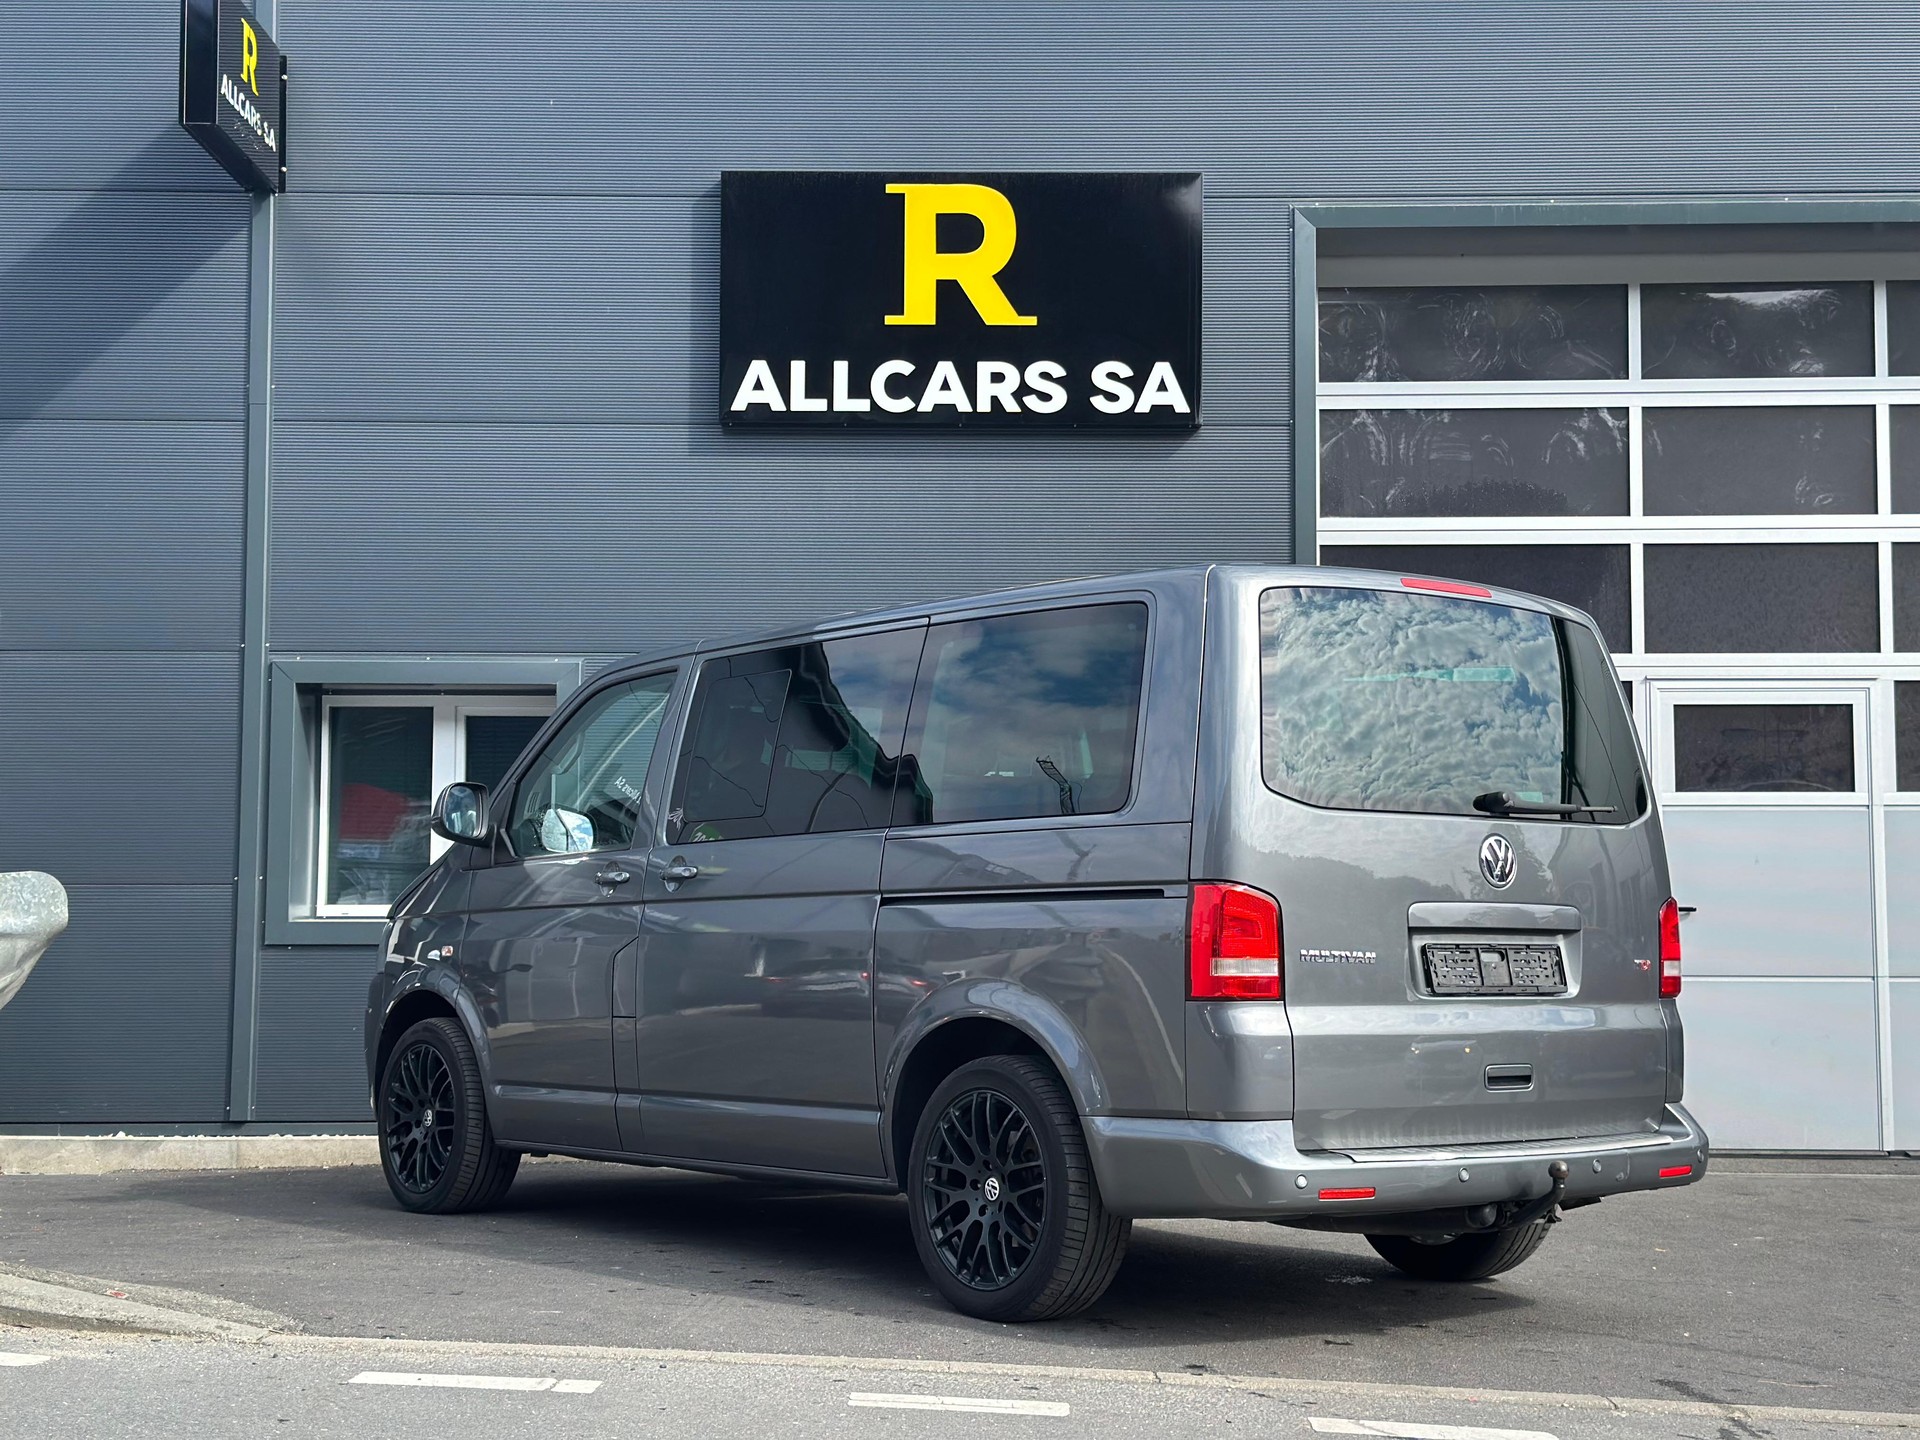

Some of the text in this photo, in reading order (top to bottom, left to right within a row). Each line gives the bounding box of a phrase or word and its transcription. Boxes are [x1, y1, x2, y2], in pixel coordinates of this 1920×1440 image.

[241, 17, 259, 96] R
[220, 73, 277, 153] ALLCARS SA
[884, 183, 1038, 326] R
[730, 359, 1191, 415] ALLCARS SA
[1300, 949, 1377, 964] MULTIVAN
